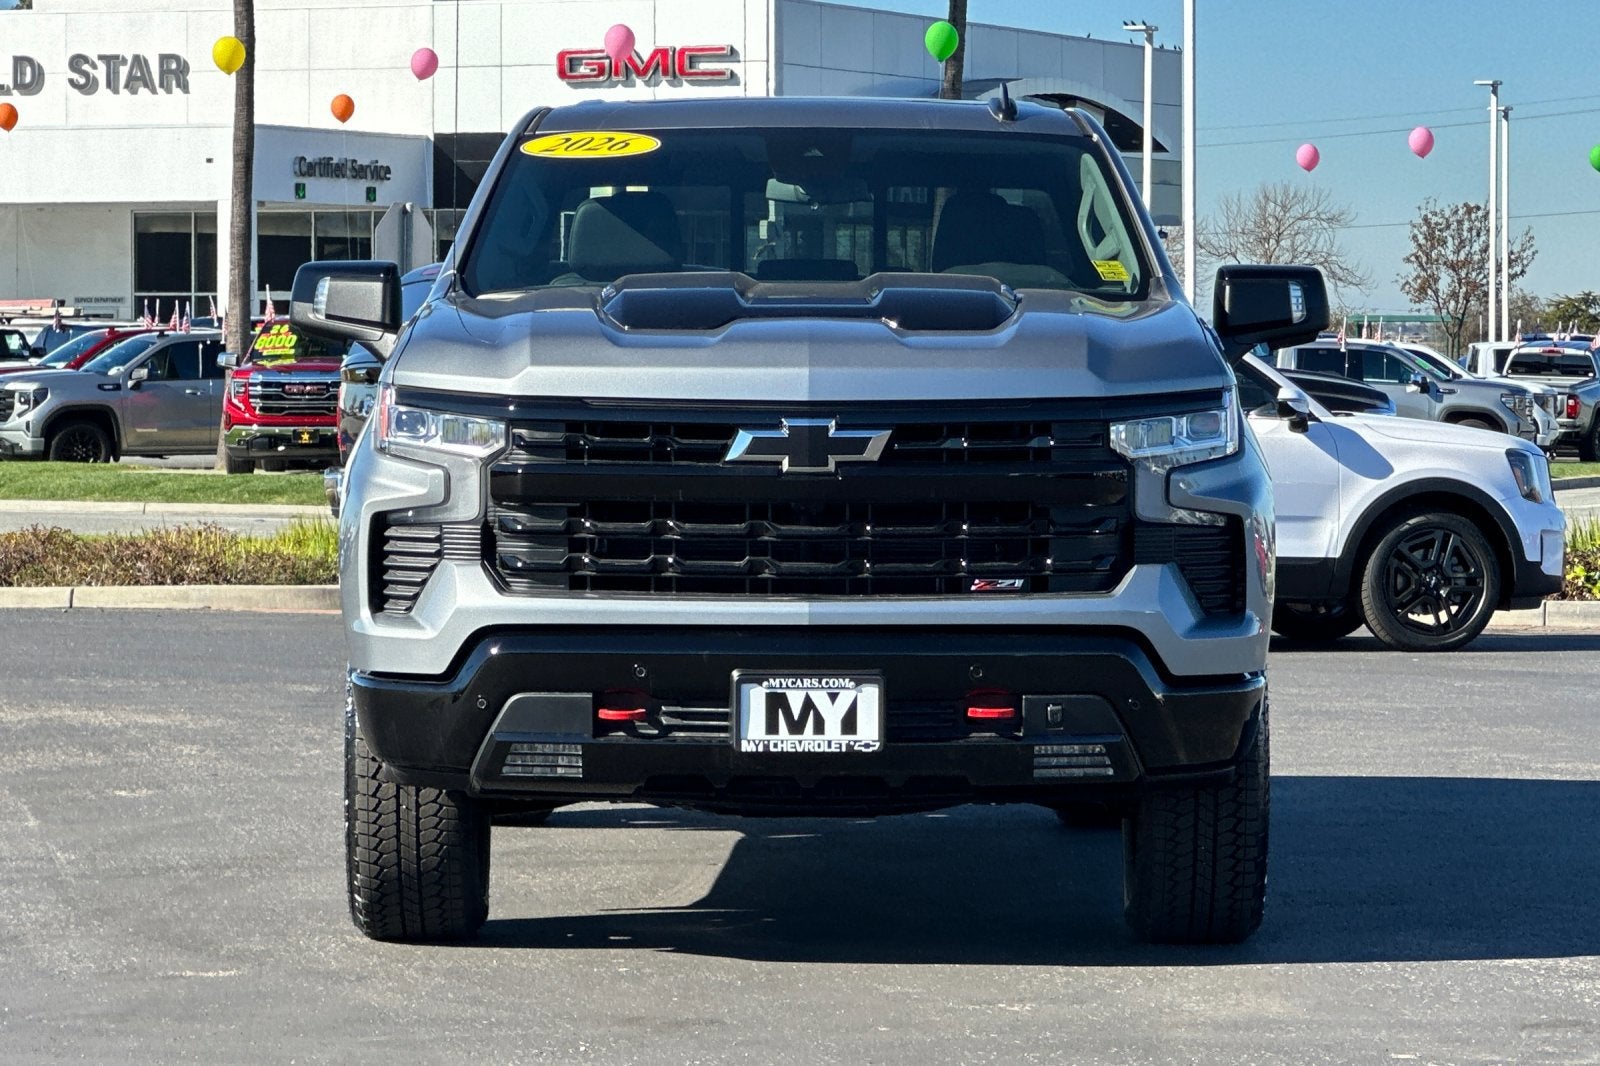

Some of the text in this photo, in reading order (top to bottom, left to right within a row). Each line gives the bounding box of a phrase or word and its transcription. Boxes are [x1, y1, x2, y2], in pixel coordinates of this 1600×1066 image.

[68, 53, 190, 95] STAR
[556, 45, 734, 82] GMC
[538, 136, 638, 152] 2026
[294, 156, 392, 181] Certified Service
[970, 578, 1024, 591] Z71
[765, 691, 858, 736] MY
[741, 740, 849, 752] MY CHEVROLET
